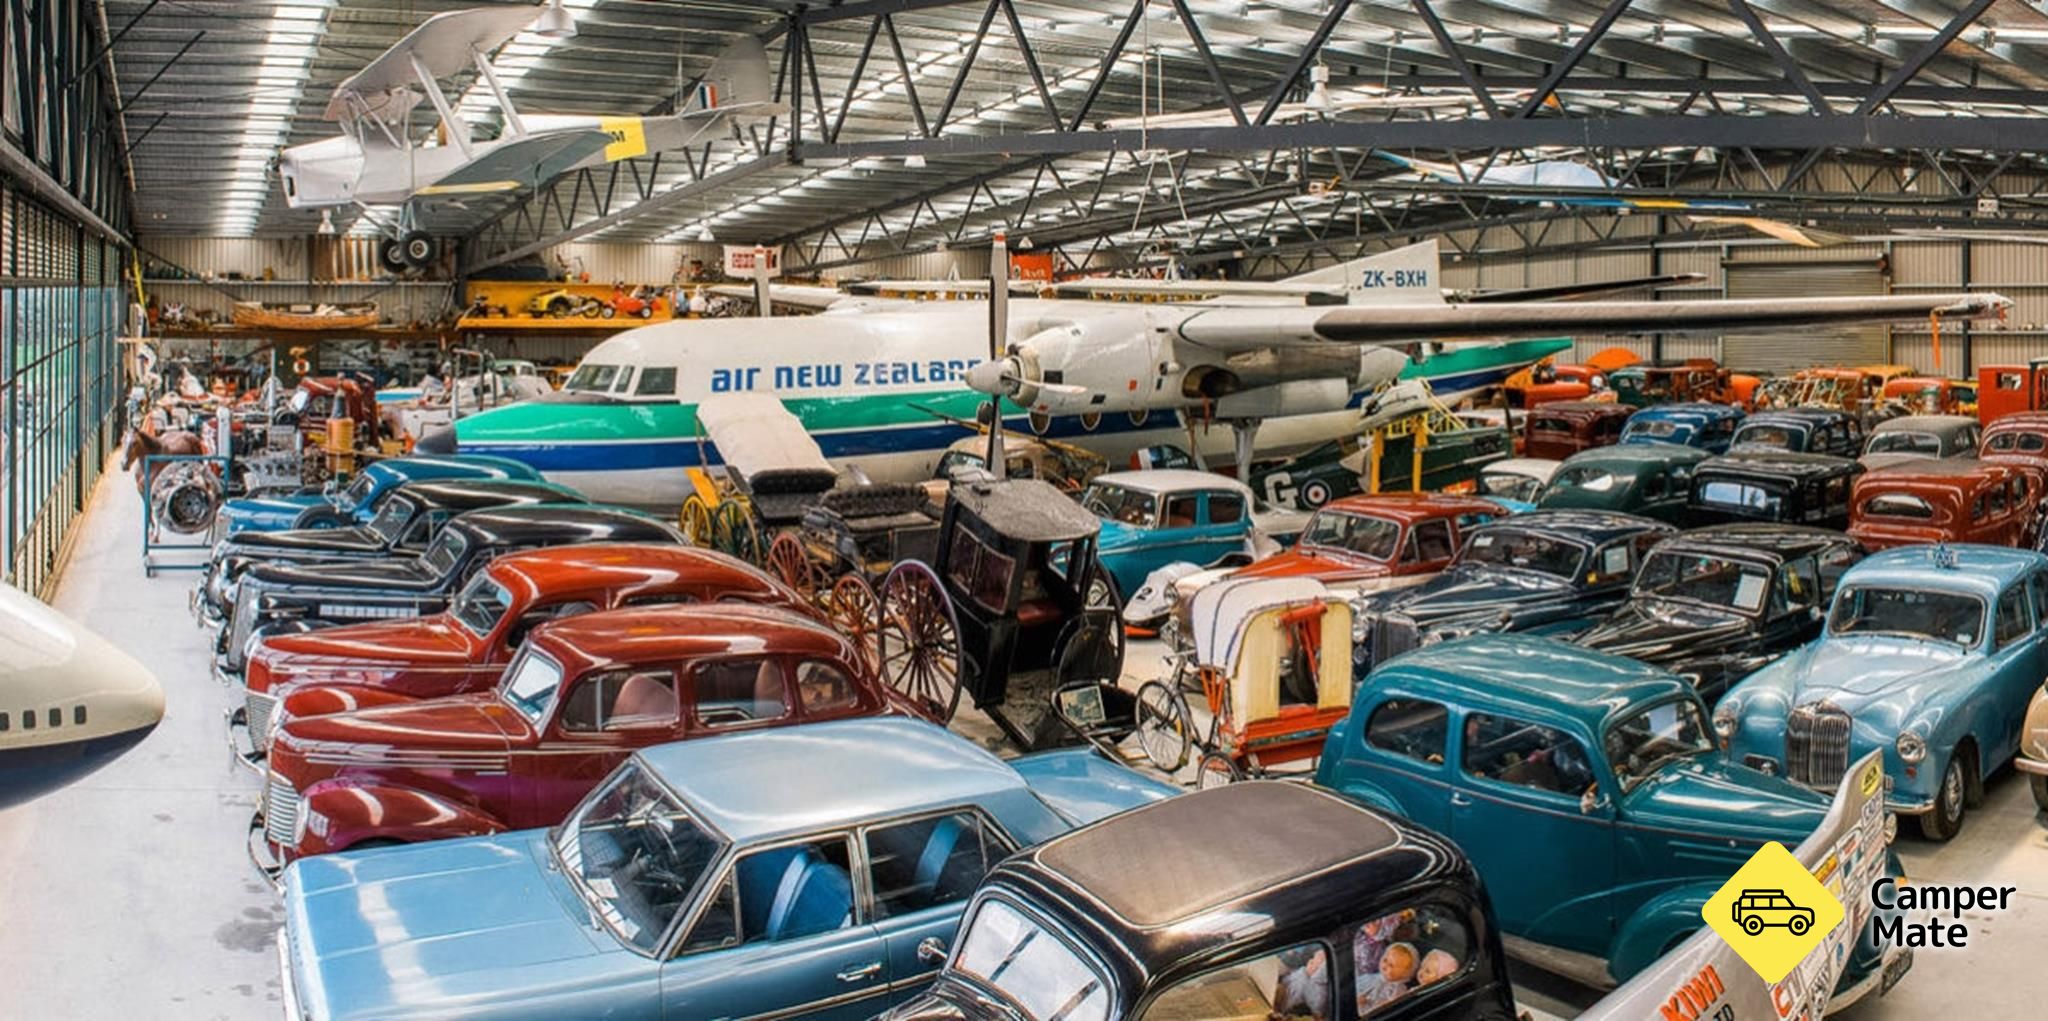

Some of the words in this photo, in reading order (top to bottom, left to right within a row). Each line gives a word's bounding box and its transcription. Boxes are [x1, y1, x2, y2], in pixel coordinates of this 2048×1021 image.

[1363, 269, 1427, 288] ZK-BXH
[1264, 471, 1298, 508] G
[1660, 964, 1726, 1021] KIWI
